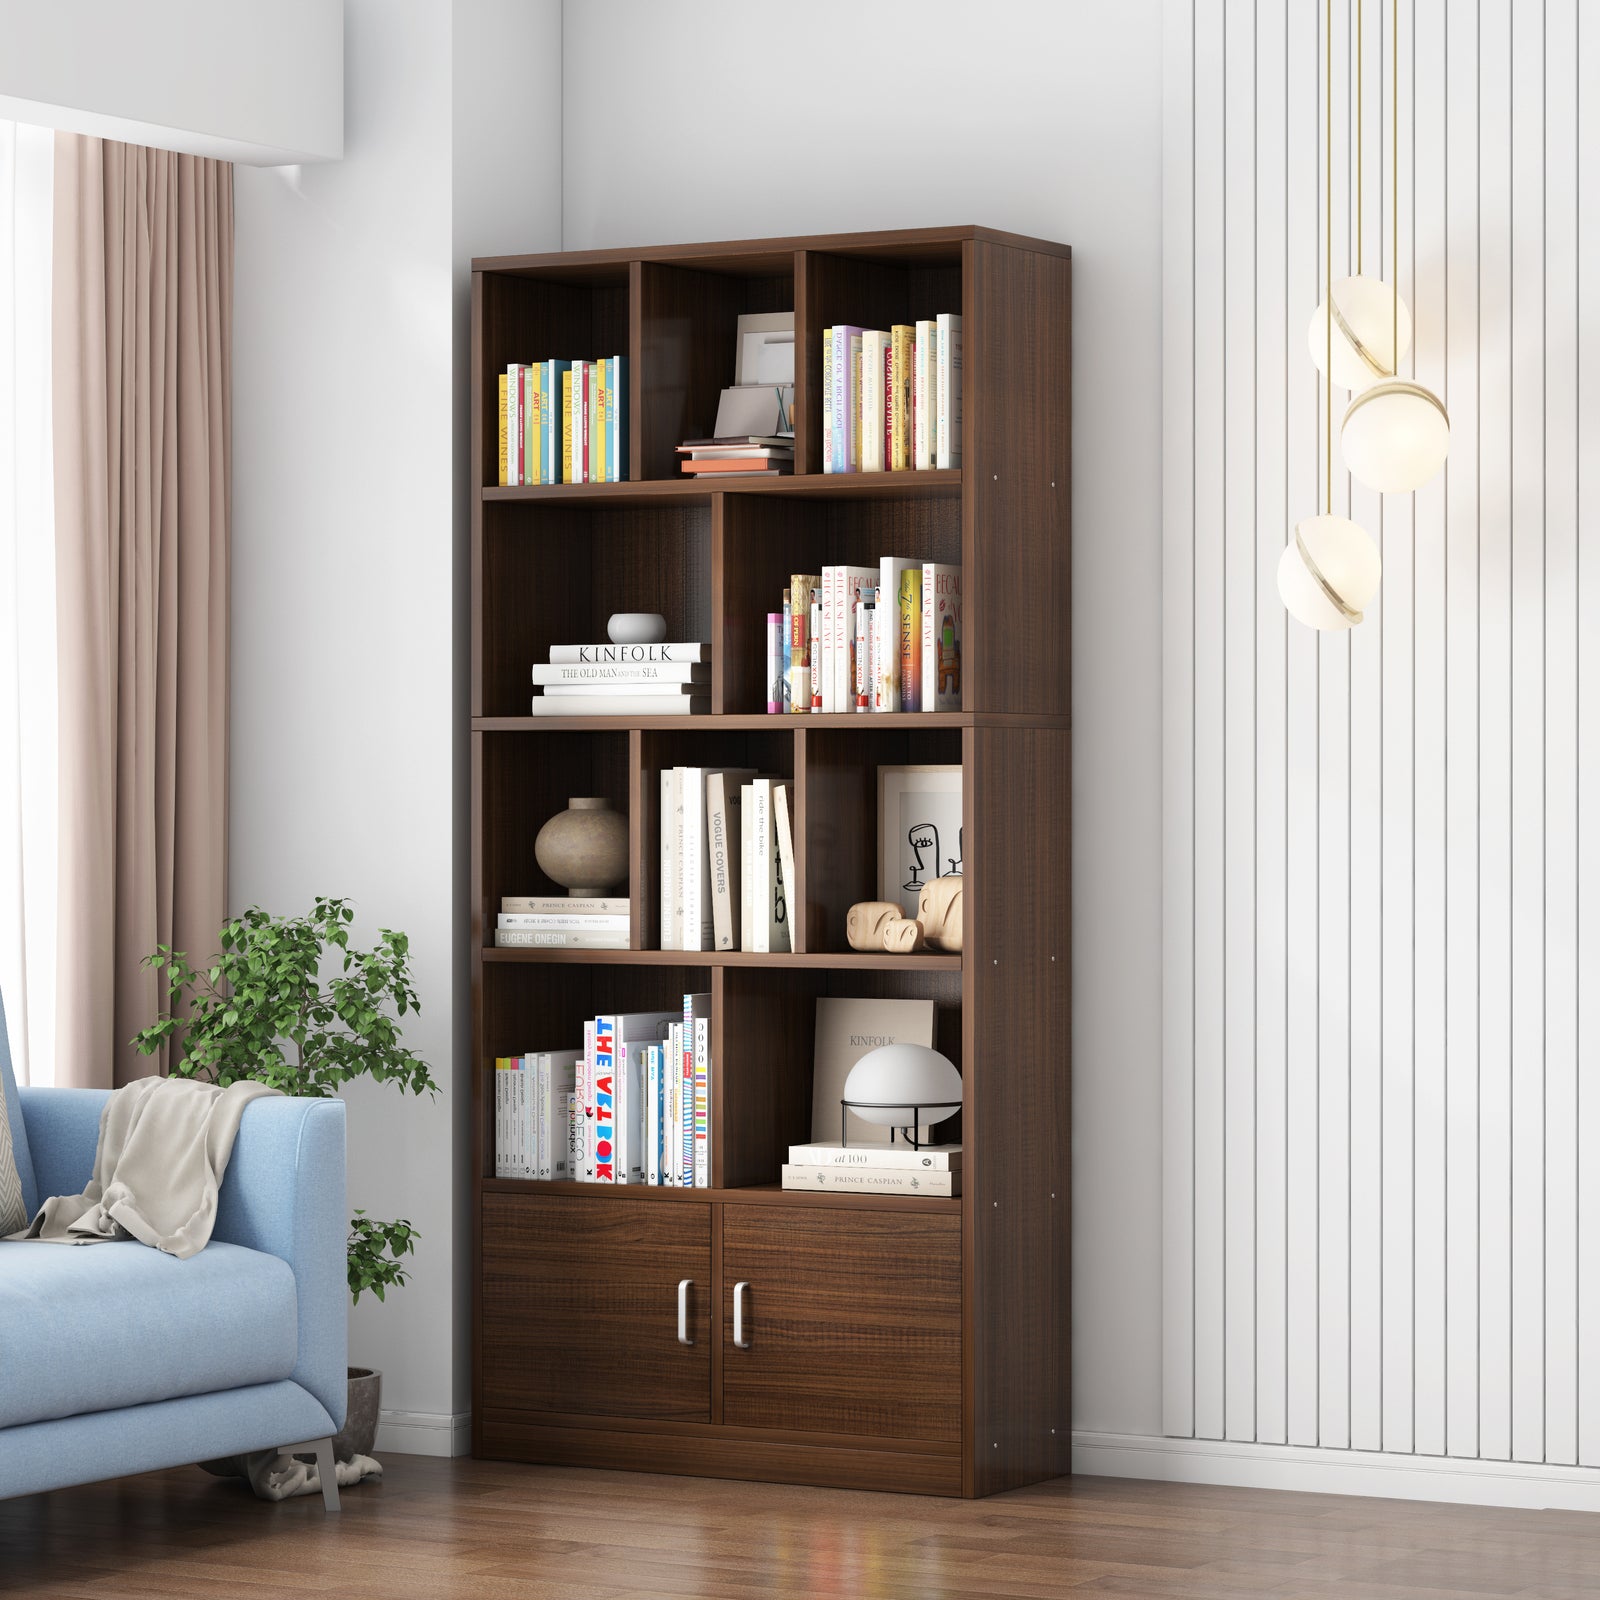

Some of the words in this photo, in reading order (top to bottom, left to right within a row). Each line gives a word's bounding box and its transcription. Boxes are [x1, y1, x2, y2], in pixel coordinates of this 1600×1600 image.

[901, 594, 912, 611] 7th
[793, 617, 799, 626] OF
[903, 614, 911, 659] SENSE
[580, 646, 672, 662] KINFOLK
[561, 669, 579, 678] THE
[580, 668, 598, 678] OLD
[599, 668, 618, 678] MAN
[642, 668, 658, 678] SEA
[907, 689, 912, 700] TO
[713, 812, 723, 848] VOGUE
[715, 851, 725, 894] COVERS
[500, 933, 532, 944] EUGENE
[535, 934, 566, 944] ONEGIN
[850, 1035, 896, 1046] KINFOLK
[835, 1154, 845, 1163] at
[847, 1154, 867, 1164] 100
[867, 1177, 903, 1185] CASPIAN
